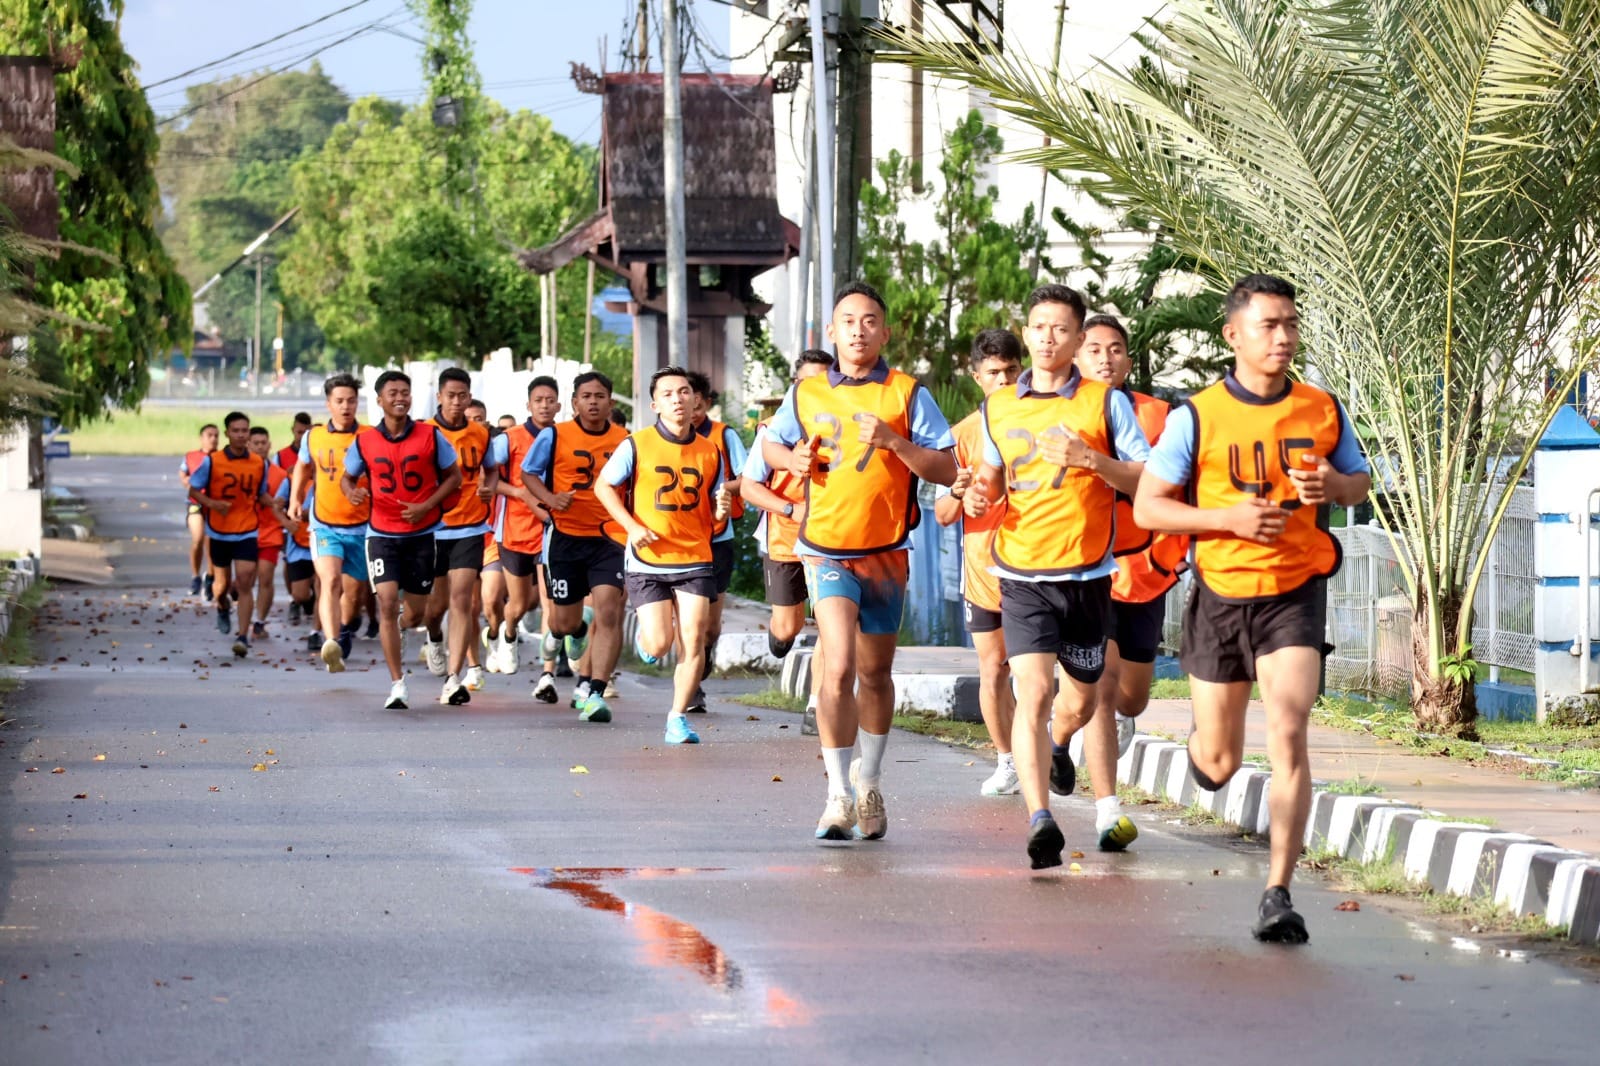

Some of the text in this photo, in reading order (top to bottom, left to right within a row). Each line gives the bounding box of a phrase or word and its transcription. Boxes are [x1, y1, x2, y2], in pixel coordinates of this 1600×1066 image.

[221, 472, 253, 498] 24
[374, 454, 423, 493] 36
[655, 465, 703, 511] 23
[552, 578, 568, 598] 29
